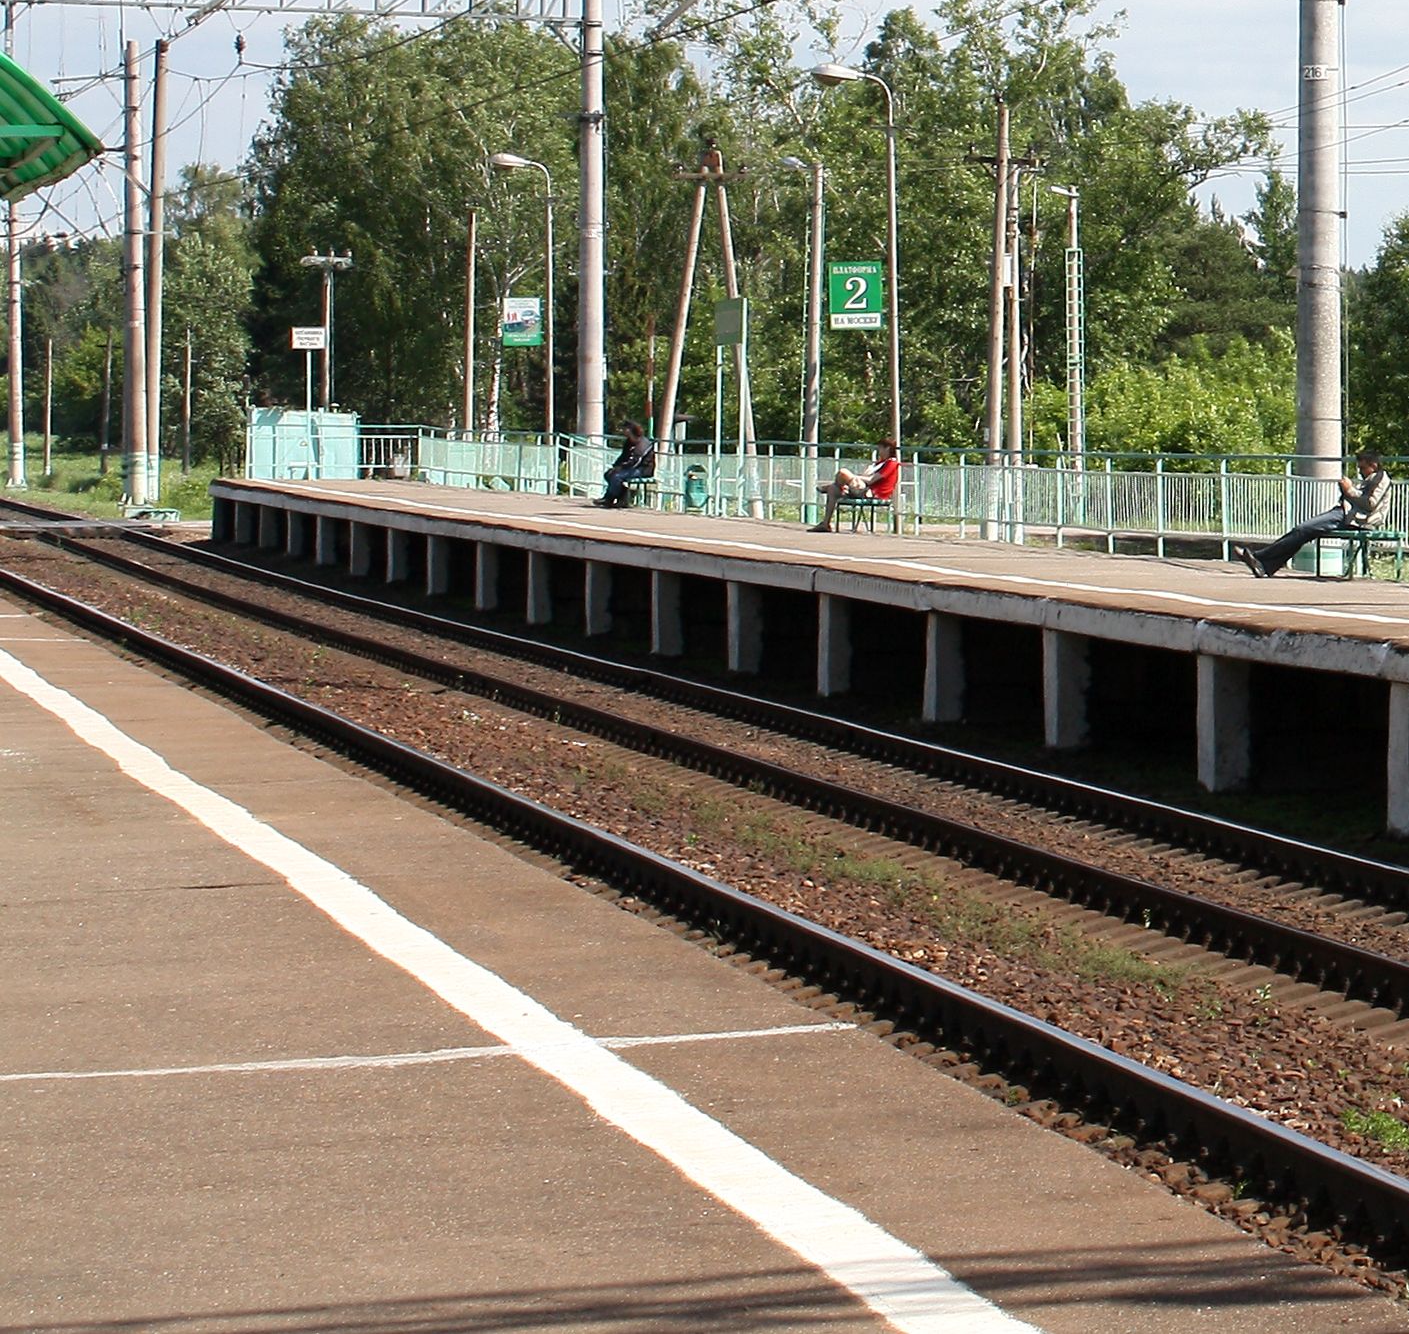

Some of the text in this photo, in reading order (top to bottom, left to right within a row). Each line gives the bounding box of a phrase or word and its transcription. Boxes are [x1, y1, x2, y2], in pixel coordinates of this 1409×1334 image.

[1303, 66, 1322, 78] 216
[832, 266, 877, 274] ПЛАТФОРМА
[844, 276, 867, 309] 2
